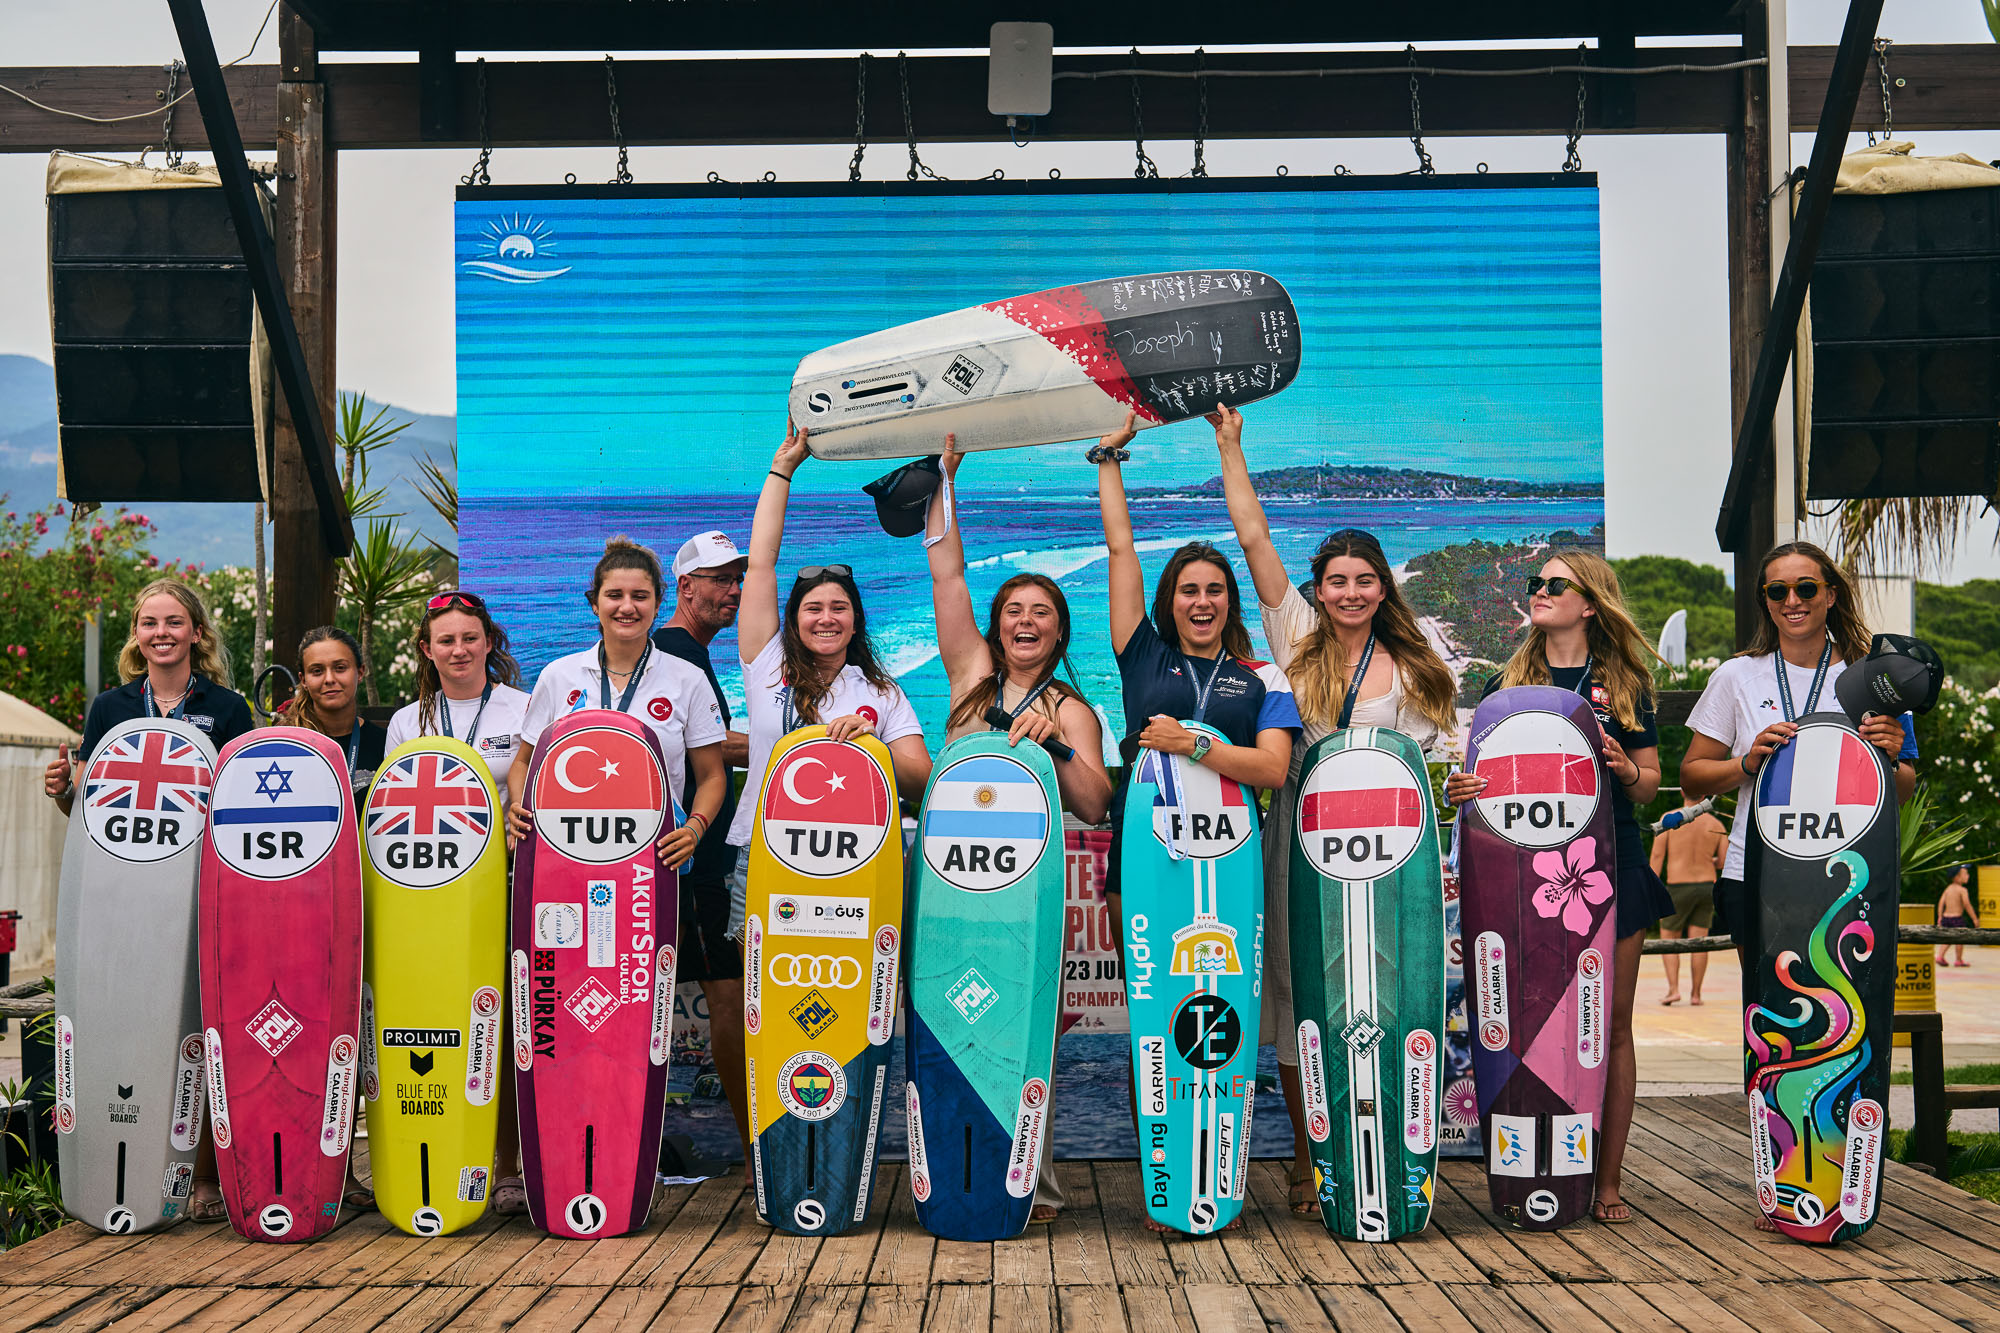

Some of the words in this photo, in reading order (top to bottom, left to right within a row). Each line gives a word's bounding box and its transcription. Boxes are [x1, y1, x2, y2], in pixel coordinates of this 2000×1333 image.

[1113, 320, 1194, 360] Joseph
[855, 370, 912, 386] WINGSANDWAVES.CO.NZ
[947, 361, 975, 388] FOIL
[958, 355, 982, 374] TARIFA
[844, 397, 900, 413] WINGSANDWAVES.CO.NZ
[104, 815, 180, 846] GBR
[560, 817, 638, 844] TUR
[1171, 813, 1236, 841] FRA
[1504, 801, 1575, 830] POL
[1777, 812, 1845, 840] FRA
[243, 831, 304, 860] ISR
[386, 841, 460, 869] GBR
[785, 828, 859, 860] TUR
[942, 844, 1016, 873] ARG
[1322, 834, 1393, 864] POL
[605, 911, 613, 942] TURKISH
[1065, 960, 1090, 980] 23
[1127, 913, 1158, 1000] Hydro
[1253, 913, 1264, 998] Hydro
[566, 979, 595, 1007] TARIFA
[619, 953, 629, 1006] KULÜBÜ
[874, 961, 885, 1013] CALABRIA
[947, 970, 975, 998] TARIFA
[1478, 936, 1490, 1019] HangLooseBeach
[1491, 964, 1502, 1015] CALABRIA
[247, 1002, 278, 1031] TARIFA
[572, 988, 613, 1025] FOIL
[590, 1001, 619, 1030] BOARDS
[655, 982, 665, 1033] CALABRIA
[791, 992, 817, 1015] TARIFA
[796, 1001, 831, 1032] FOIL
[882, 957, 895, 1040] HangLooseBeach
[953, 981, 991, 1017] FOIL
[969, 994, 997, 1021] BOARDS
[1582, 985, 1591, 1036] CALABRIA
[255, 1012, 293, 1048] FOIL
[534, 976, 562, 1059] PÜRKAY
[810, 1014, 837, 1037] BOARDS
[1592, 980, 1601, 1063] HangLooseBeach
[272, 1025, 301, 1055] BOARDS
[385, 1031, 458, 1045] PROLIMIT
[472, 1022, 484, 1073] CALABRIA
[1347, 1022, 1378, 1051] FOIL
[483, 1018, 496, 1101] HangLooseBeach
[811, 1054, 835, 1070] SPOR
[1151, 1041, 1164, 1114] GARMIN
[1300, 1026, 1314, 1110] HangLooseBeach
[179, 1069, 192, 1119] CALABRIA
[397, 1083, 423, 1099] BLUE
[428, 1083, 448, 1099] FOX
[1311, 1052, 1322, 1104] CALABRIA
[1410, 1067, 1420, 1120] CALABRIA
[108, 1103, 125, 1114] BLUE
[127, 1104, 140, 1114] FOX
[188, 1065, 205, 1146] HangLooseBeach
[328, 1072, 341, 1124] CALABRIA
[337, 1067, 352, 1151] HangLooseBeach
[401, 1100, 444, 1116] BOARDS
[802, 1109, 822, 1118] 1907
[1421, 1063, 1433, 1149] HangLooseBeach
[110, 1114, 138, 1124] BOARDS
[1015, 1114, 1030, 1165] CALABRIA
[1022, 1110, 1042, 1193] HangLooseBeach
[1501, 1124, 1528, 1168] Sopot
[1559, 1123, 1585, 1165] Sopot
[1759, 1123, 1769, 1175] CALABRIA
[1239, 1141, 1249, 1194] Entreprises
[1848, 1136, 1863, 1189] CALABRIA
[1859, 1133, 1878, 1220] HangLooseBeach
[855, 1181, 867, 1220] YELKEN
[1316, 1159, 1339, 1207] Sopot
[1402, 1161, 1427, 1209] Sopot
